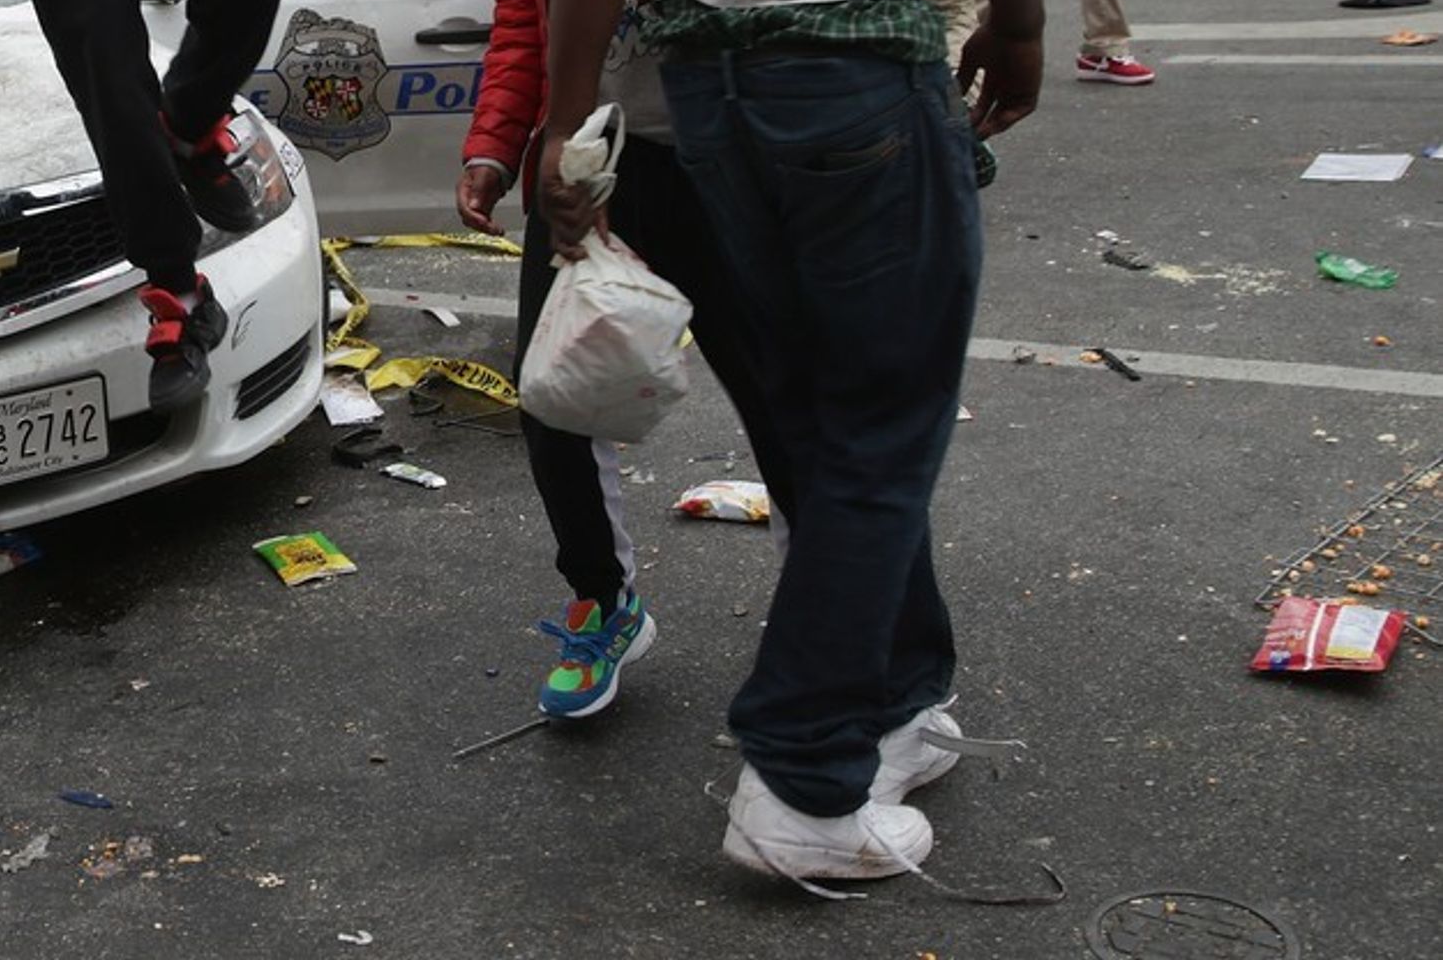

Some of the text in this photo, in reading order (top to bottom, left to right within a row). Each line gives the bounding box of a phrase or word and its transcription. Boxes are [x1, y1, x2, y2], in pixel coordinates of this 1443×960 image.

[395, 67, 484, 110] Pol
[17, 403, 99, 459] 2742
[44, 455, 64, 468] City
